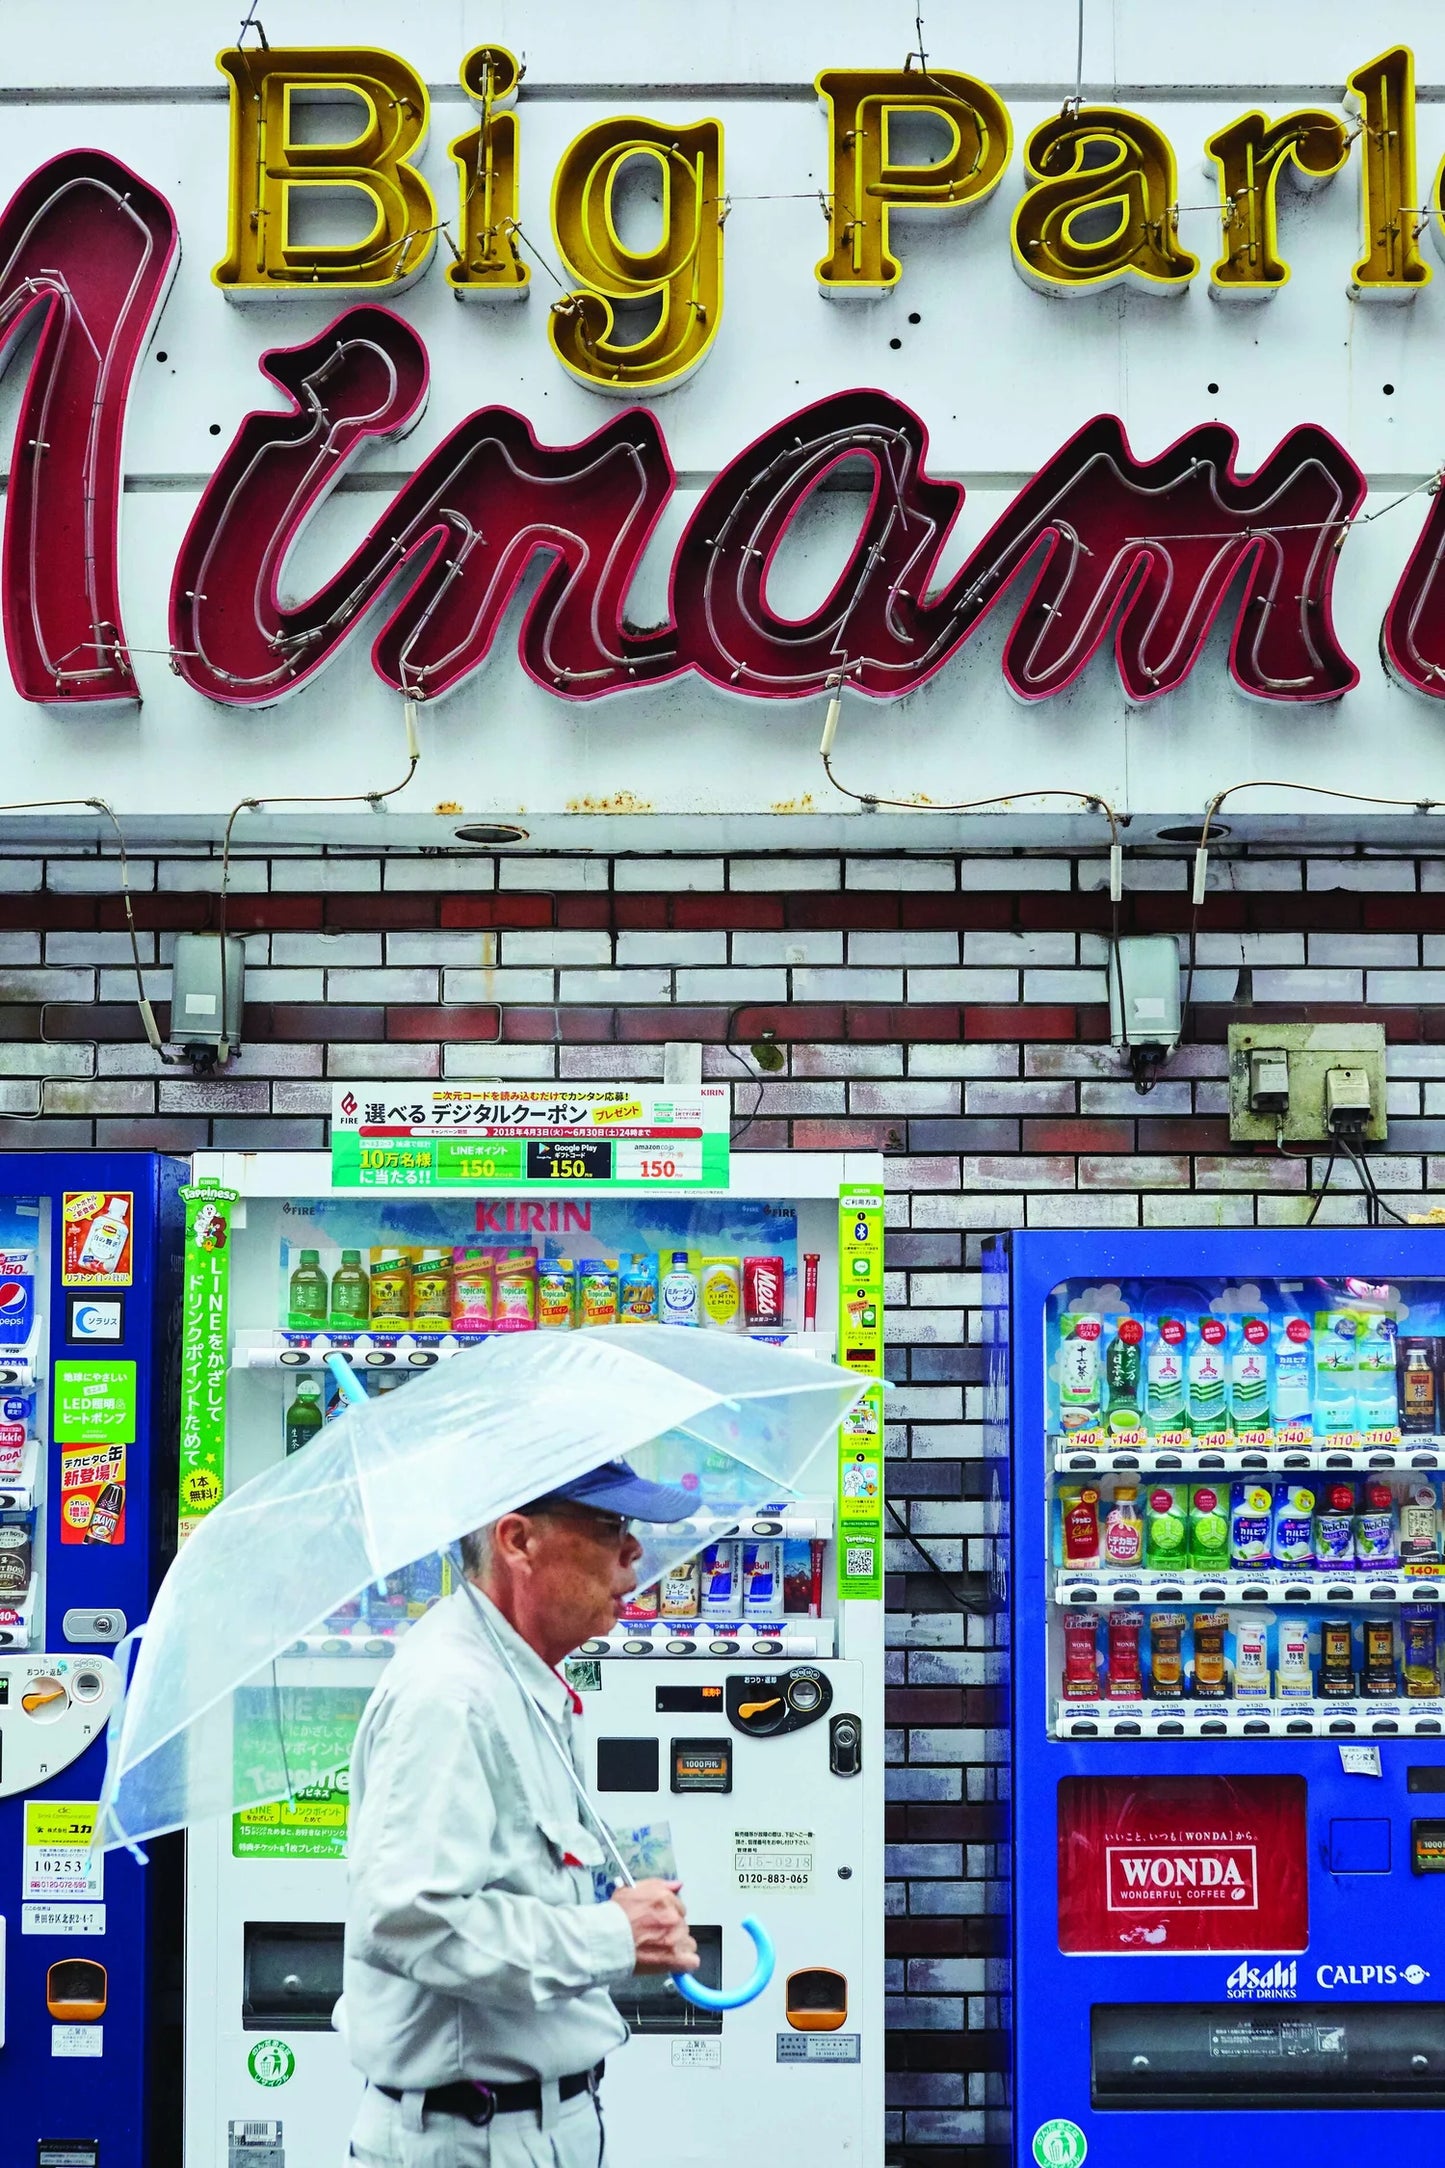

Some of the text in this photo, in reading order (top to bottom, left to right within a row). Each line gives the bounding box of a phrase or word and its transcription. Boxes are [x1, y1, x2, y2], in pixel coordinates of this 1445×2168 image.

[211, 43, 1445, 394] Big Parl
[364, 1103, 640, 1125] 選べる デジタルクーポン プレゼント
[340, 1117, 359, 1125] FIRE
[450, 1145, 509, 1156] LINEポイント
[554, 1144, 598, 1153] Google Play
[360, 1150, 432, 1169] 10万名様
[460, 1160, 495, 1177] 150
[550, 1160, 586, 1178] 150
[641, 1161, 676, 1178] 150
[181, 1187, 238, 1201] Tappiness
[291, 1207, 315, 1216] FIRE
[475, 1201, 592, 1233] KIRIN
[773, 1208, 796, 1218] FIRE
[757, 1267, 775, 1315] Mets
[88, 1317, 118, 1325] ソラリス
[206, 1257, 225, 1422] LINEをかざして
[1076, 1345, 1088, 1380] 十六茶
[184, 1274, 205, 1466] ドリンクポイントためて
[63, 1373, 128, 1382] 地球にやさしい
[1070, 1434, 1095, 1444] ¥140
[1113, 1433, 1138, 1444] ¥140
[1156, 1433, 1182, 1444] ¥140
[1200, 1434, 1225, 1446] ¥140
[1240, 1433, 1265, 1444] ¥140
[1278, 1432, 1303, 1443] ¥140
[64, 1463, 119, 1487] 新登場!
[190, 1476, 209, 1488] 1本
[189, 1487, 218, 1502] 無料!
[1240, 1527, 1266, 1535] カルピス
[1108, 1536, 1138, 1545] ドデカミン
[1108, 1546, 1136, 1555] ストロング
[1410, 1566, 1439, 1575] 140円
[685, 1761, 719, 1769] 1000円札
[249, 1804, 272, 1814] LINE
[68, 1825, 92, 1834] ユカ
[1120, 1858, 1244, 1887] WONDA
[738, 1874, 808, 1883] 0120-883-065
[1120, 1890, 1226, 1900] WONDERFUL COFFEE
[1226, 1960, 1297, 1989] Asahi
[1316, 1965, 1398, 1989] CALPIS
[1227, 1990, 1297, 1999] SOFT DRINKS
